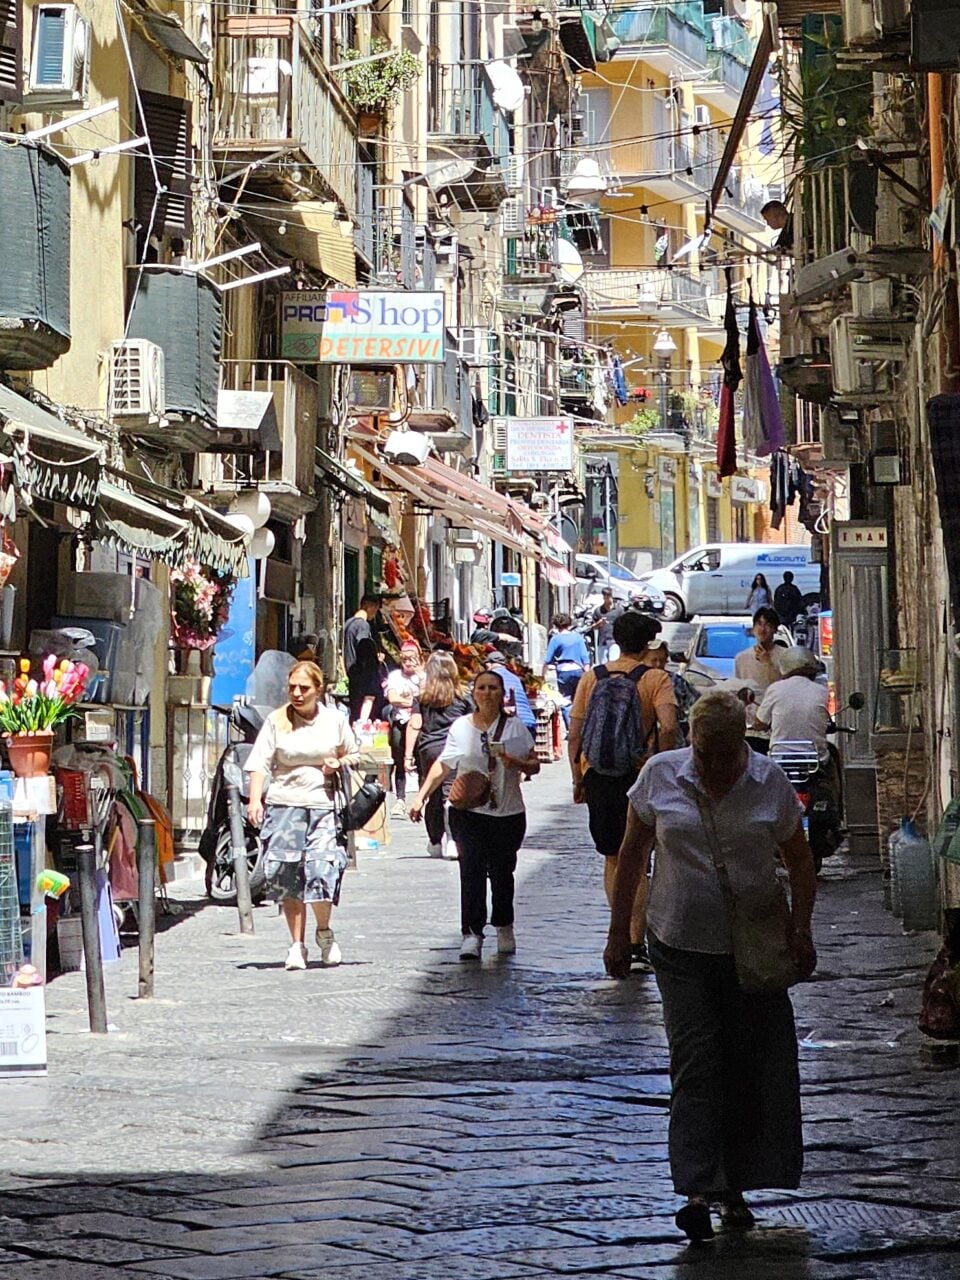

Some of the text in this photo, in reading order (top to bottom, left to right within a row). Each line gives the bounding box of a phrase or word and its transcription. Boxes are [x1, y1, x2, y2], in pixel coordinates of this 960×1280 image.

[284, 293, 330, 302] AFFILIATO
[350, 297, 442, 333] Shop
[320, 336, 441, 357] DETERSIVI
[517, 431, 561, 439] DENTISTA
